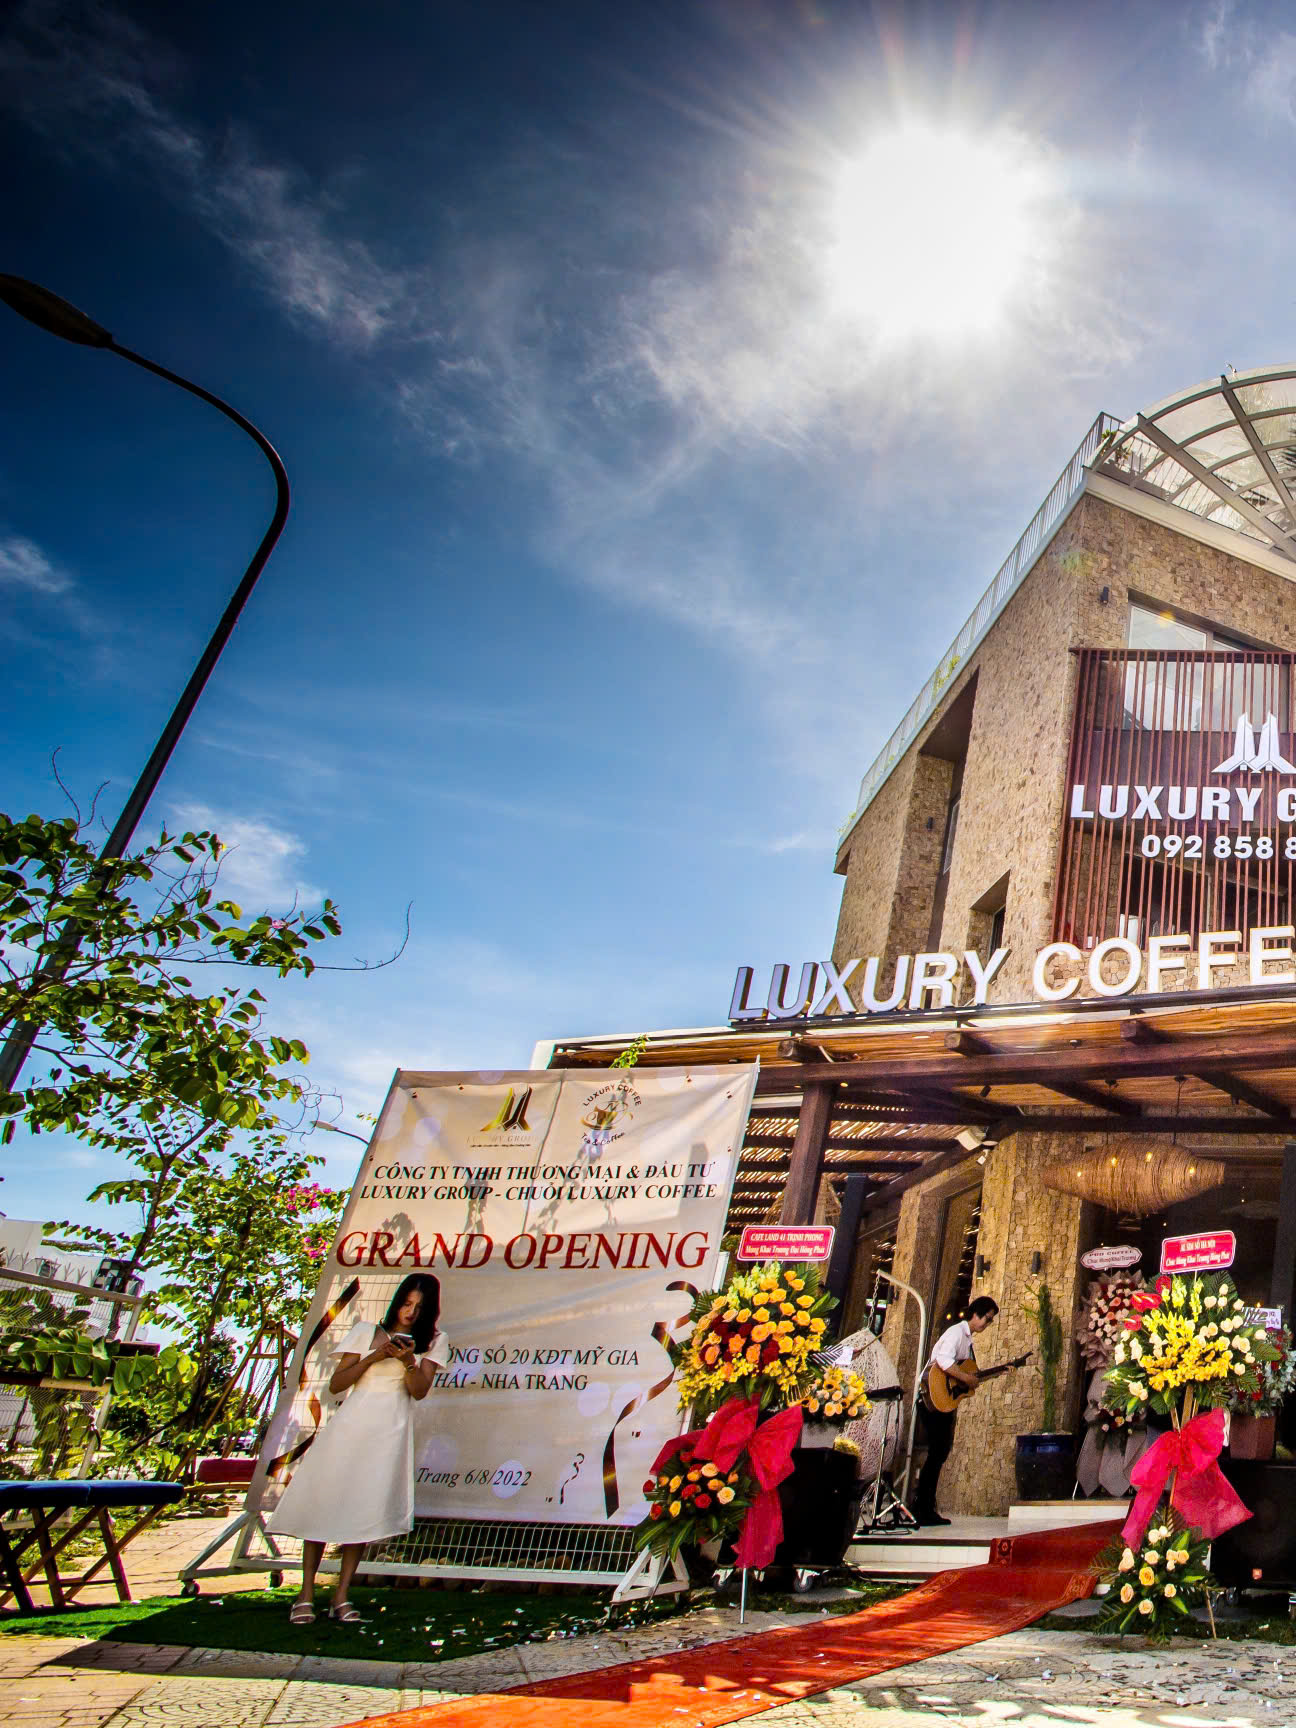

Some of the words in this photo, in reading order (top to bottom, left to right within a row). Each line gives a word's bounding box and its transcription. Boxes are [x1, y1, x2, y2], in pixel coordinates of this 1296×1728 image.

[1070, 784, 1263, 822] LUXURY
[1141, 834, 1202, 858] 092
[1213, 835, 1274, 860] 858
[728, 948, 1012, 1020] LUXURY
[582, 1084, 615, 1106] LUXURY
[617, 1084, 642, 1106] COFFEE
[374, 1162, 425, 1180] CÔNG
[430, 1166, 449, 1180] TY
[452, 1166, 503, 1180] TNHH
[506, 1164, 581, 1180] THƯƠNG
[583, 1165, 623, 1183] MẠI
[626, 1165, 640, 1179] &
[688, 1161, 716, 1178] TƯ
[360, 1185, 433, 1199] LUXURY
[434, 1185, 494, 1200] GROUP
[567, 1184, 642, 1200] LUXURY
[645, 1184, 717, 1199] COFFEE
[336, 1231, 494, 1269] GRAND
[504, 1231, 710, 1269] OPENING
[483, 1344, 507, 1364] SỐ
[509, 1350, 530, 1365] 20
[532, 1350, 572, 1365] KĐT
[573, 1346, 605, 1365] MỸ
[607, 1350, 639, 1365] GIA
[433, 1369, 469, 1388] HÁI
[481, 1373, 519, 1389] NHA
[525, 1374, 588, 1390] TRANG
[416, 1467, 461, 1488] Trang
[464, 1469, 532, 1487] 6/8/2022
